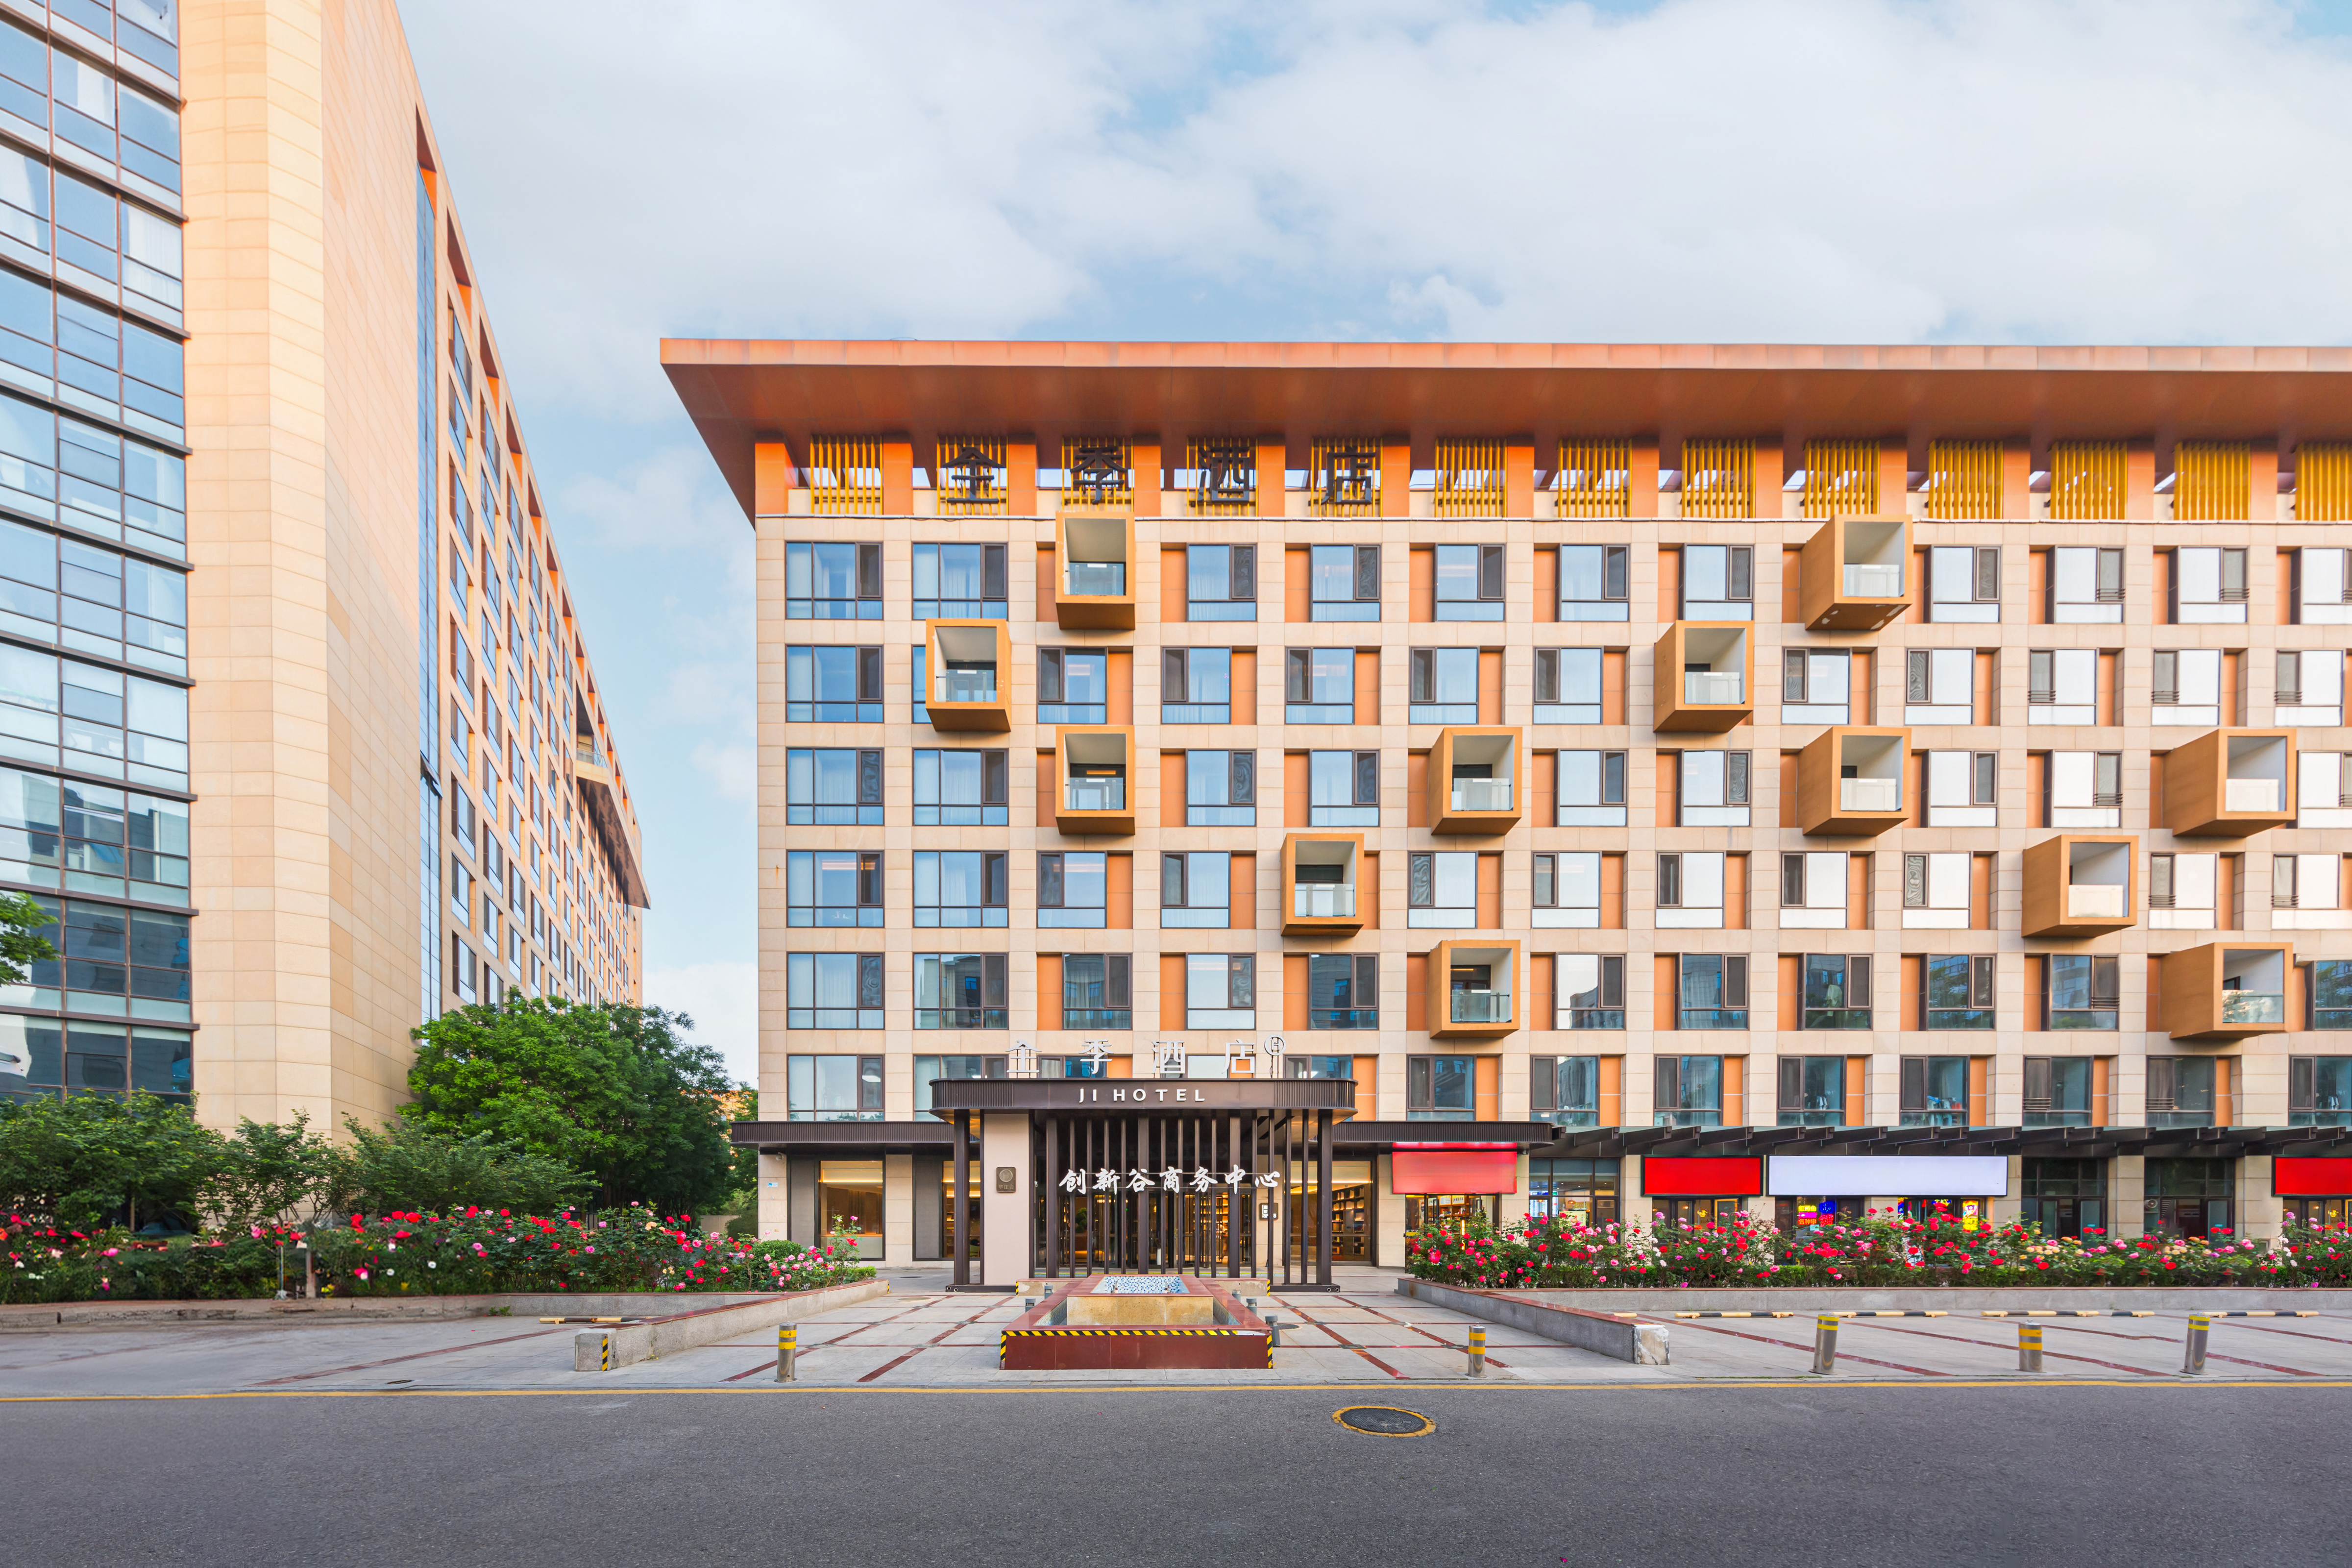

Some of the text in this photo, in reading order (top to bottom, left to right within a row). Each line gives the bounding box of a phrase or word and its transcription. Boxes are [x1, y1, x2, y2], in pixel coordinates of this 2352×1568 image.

[943, 445, 1376, 505] 全季酒店
[1005, 1039, 1255, 1075] 全季酒店
[1079, 1088, 1205, 1103] JI HOTEL
[1059, 1164, 1280, 1195] 创新谷商务中心
